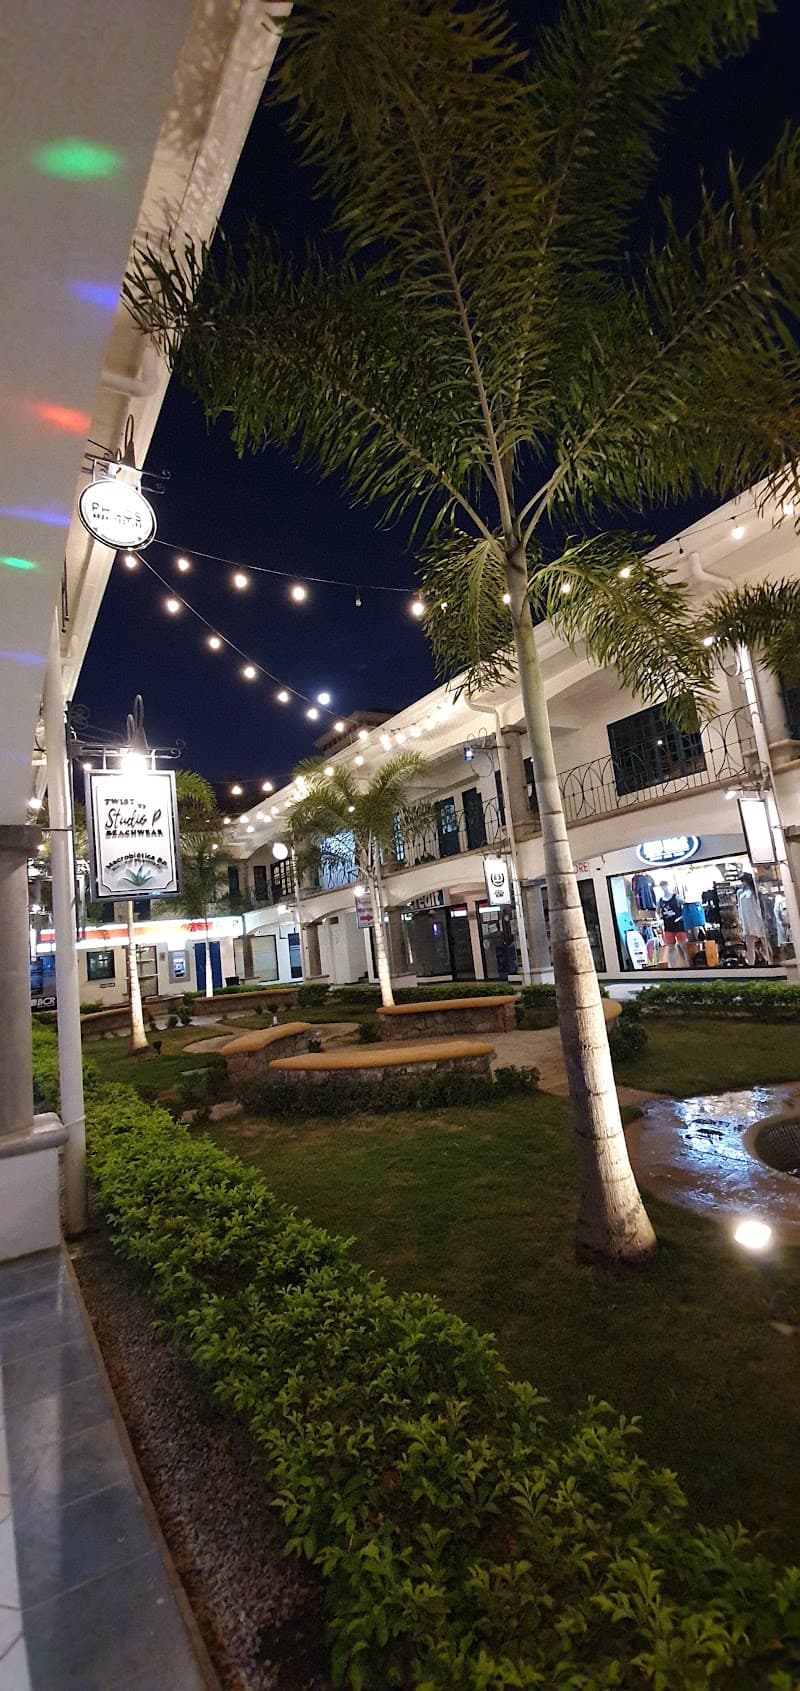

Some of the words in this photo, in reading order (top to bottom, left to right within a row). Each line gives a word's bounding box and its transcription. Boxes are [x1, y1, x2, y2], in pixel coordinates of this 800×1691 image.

[105, 807, 147, 830] Studio
[151, 808, 162, 828] P
[105, 829, 163, 839] BEACHWEAR
